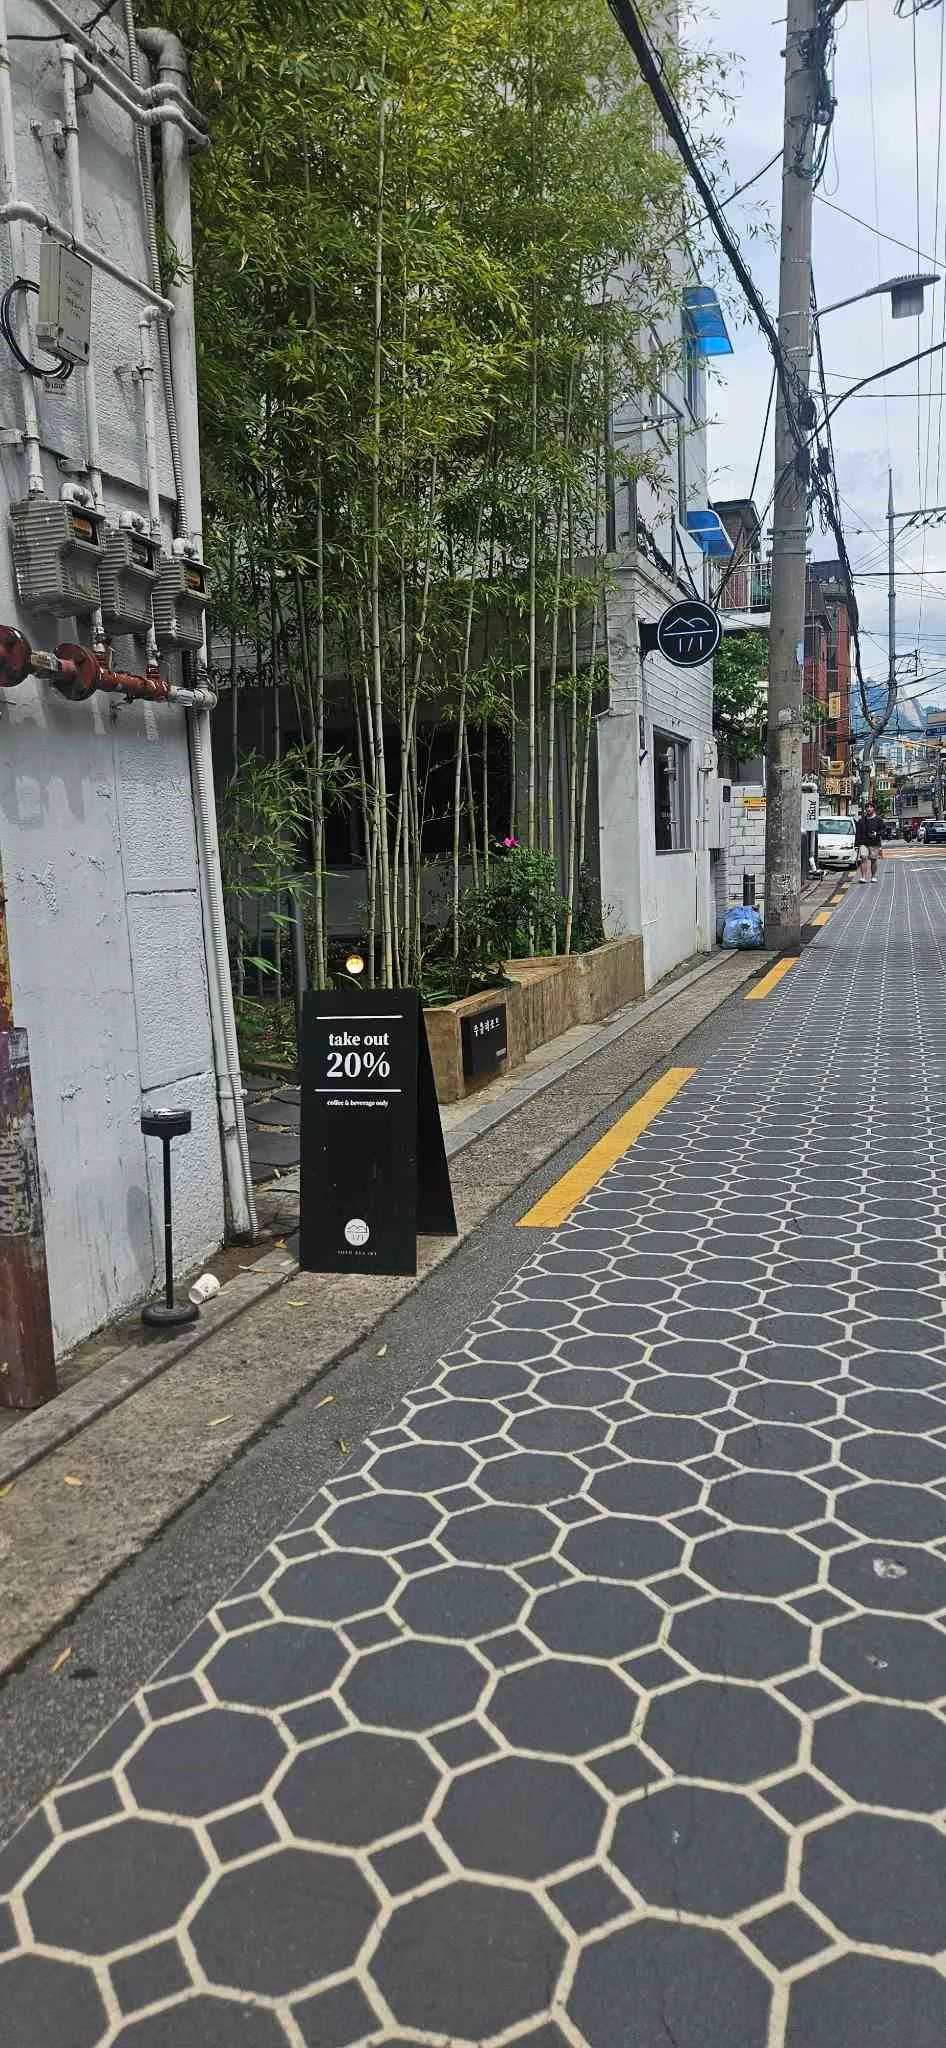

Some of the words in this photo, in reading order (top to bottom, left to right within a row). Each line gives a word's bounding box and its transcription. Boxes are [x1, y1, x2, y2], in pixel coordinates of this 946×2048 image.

[329, 1032, 361, 1046] take
[363, 1033, 390, 1046] out
[327, 1051, 391, 1078] 20%
[350, 1099, 375, 1107] beverage
[376, 1099, 389, 1109] only
